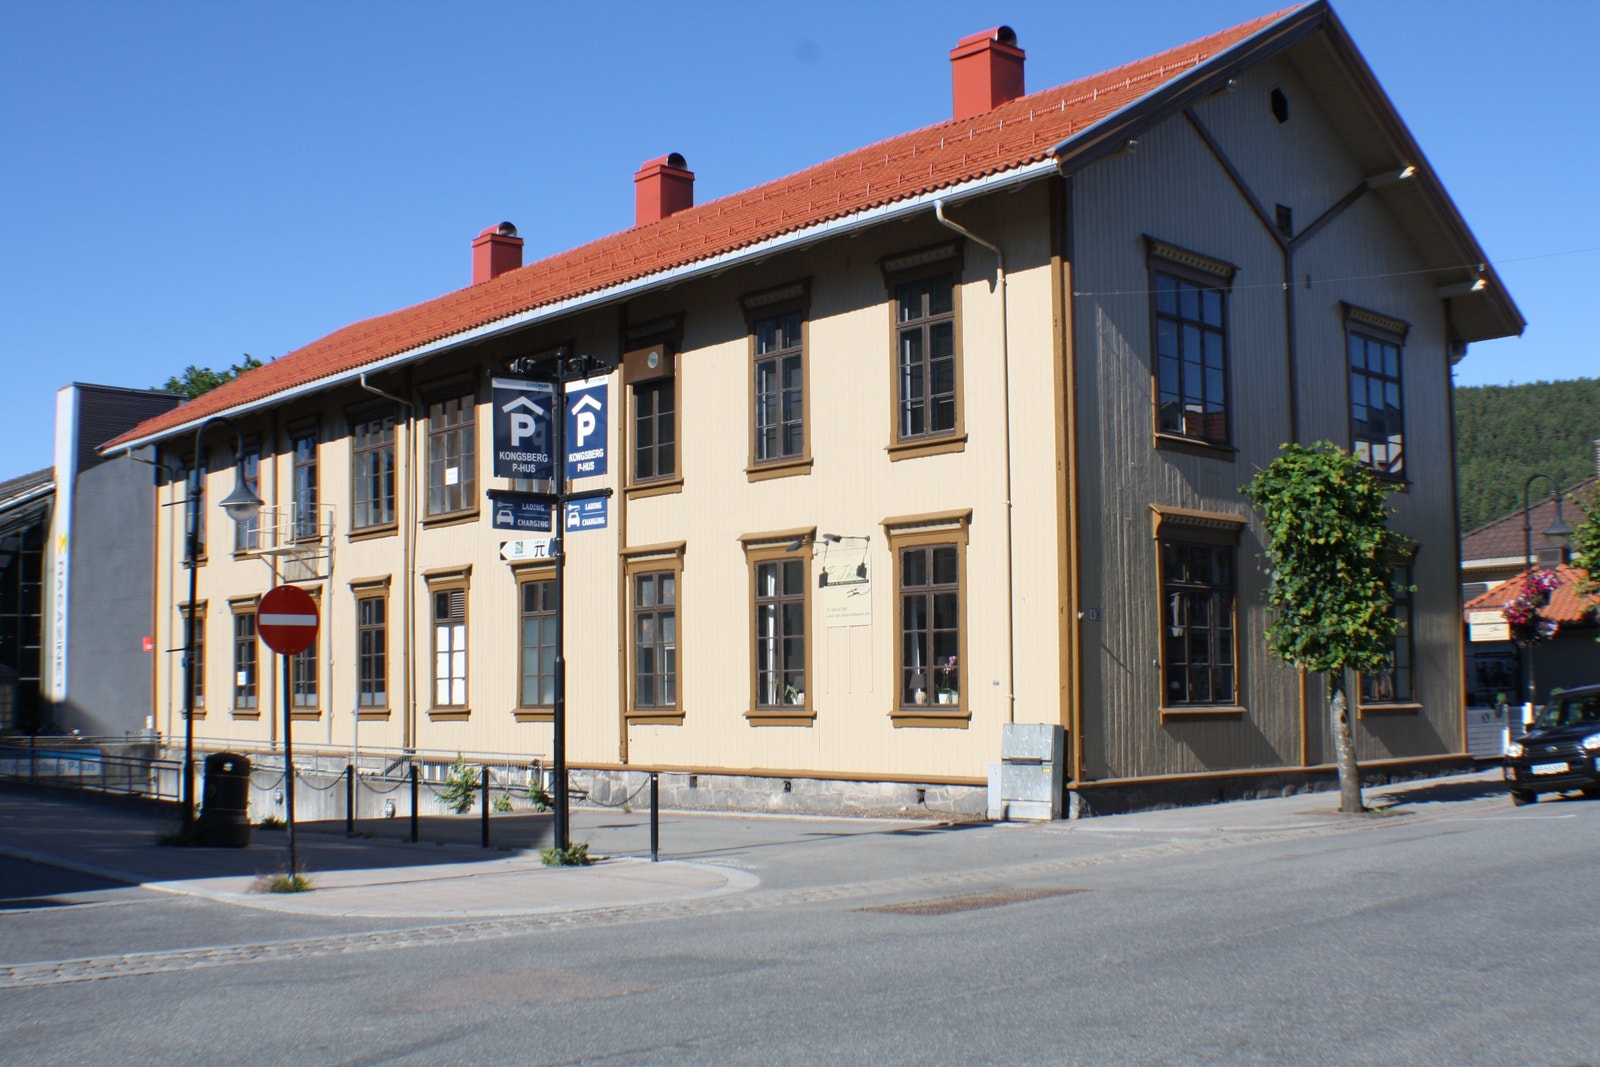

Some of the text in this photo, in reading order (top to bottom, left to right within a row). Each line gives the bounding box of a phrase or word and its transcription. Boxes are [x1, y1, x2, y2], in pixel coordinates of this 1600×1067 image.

[510, 412, 536, 447] P
[576, 411, 596, 447] P
[499, 451, 548, 462] KONGSBERG
[568, 448, 604, 462] KONGSBERG
[512, 463, 536, 473] P-HUS
[577, 461, 595, 473] P-HUS
[521, 502, 545, 511] LADING
[584, 501, 602, 511] LADING
[517, 518, 549, 528] CHARGING
[581, 516, 605, 527] CHARGING
